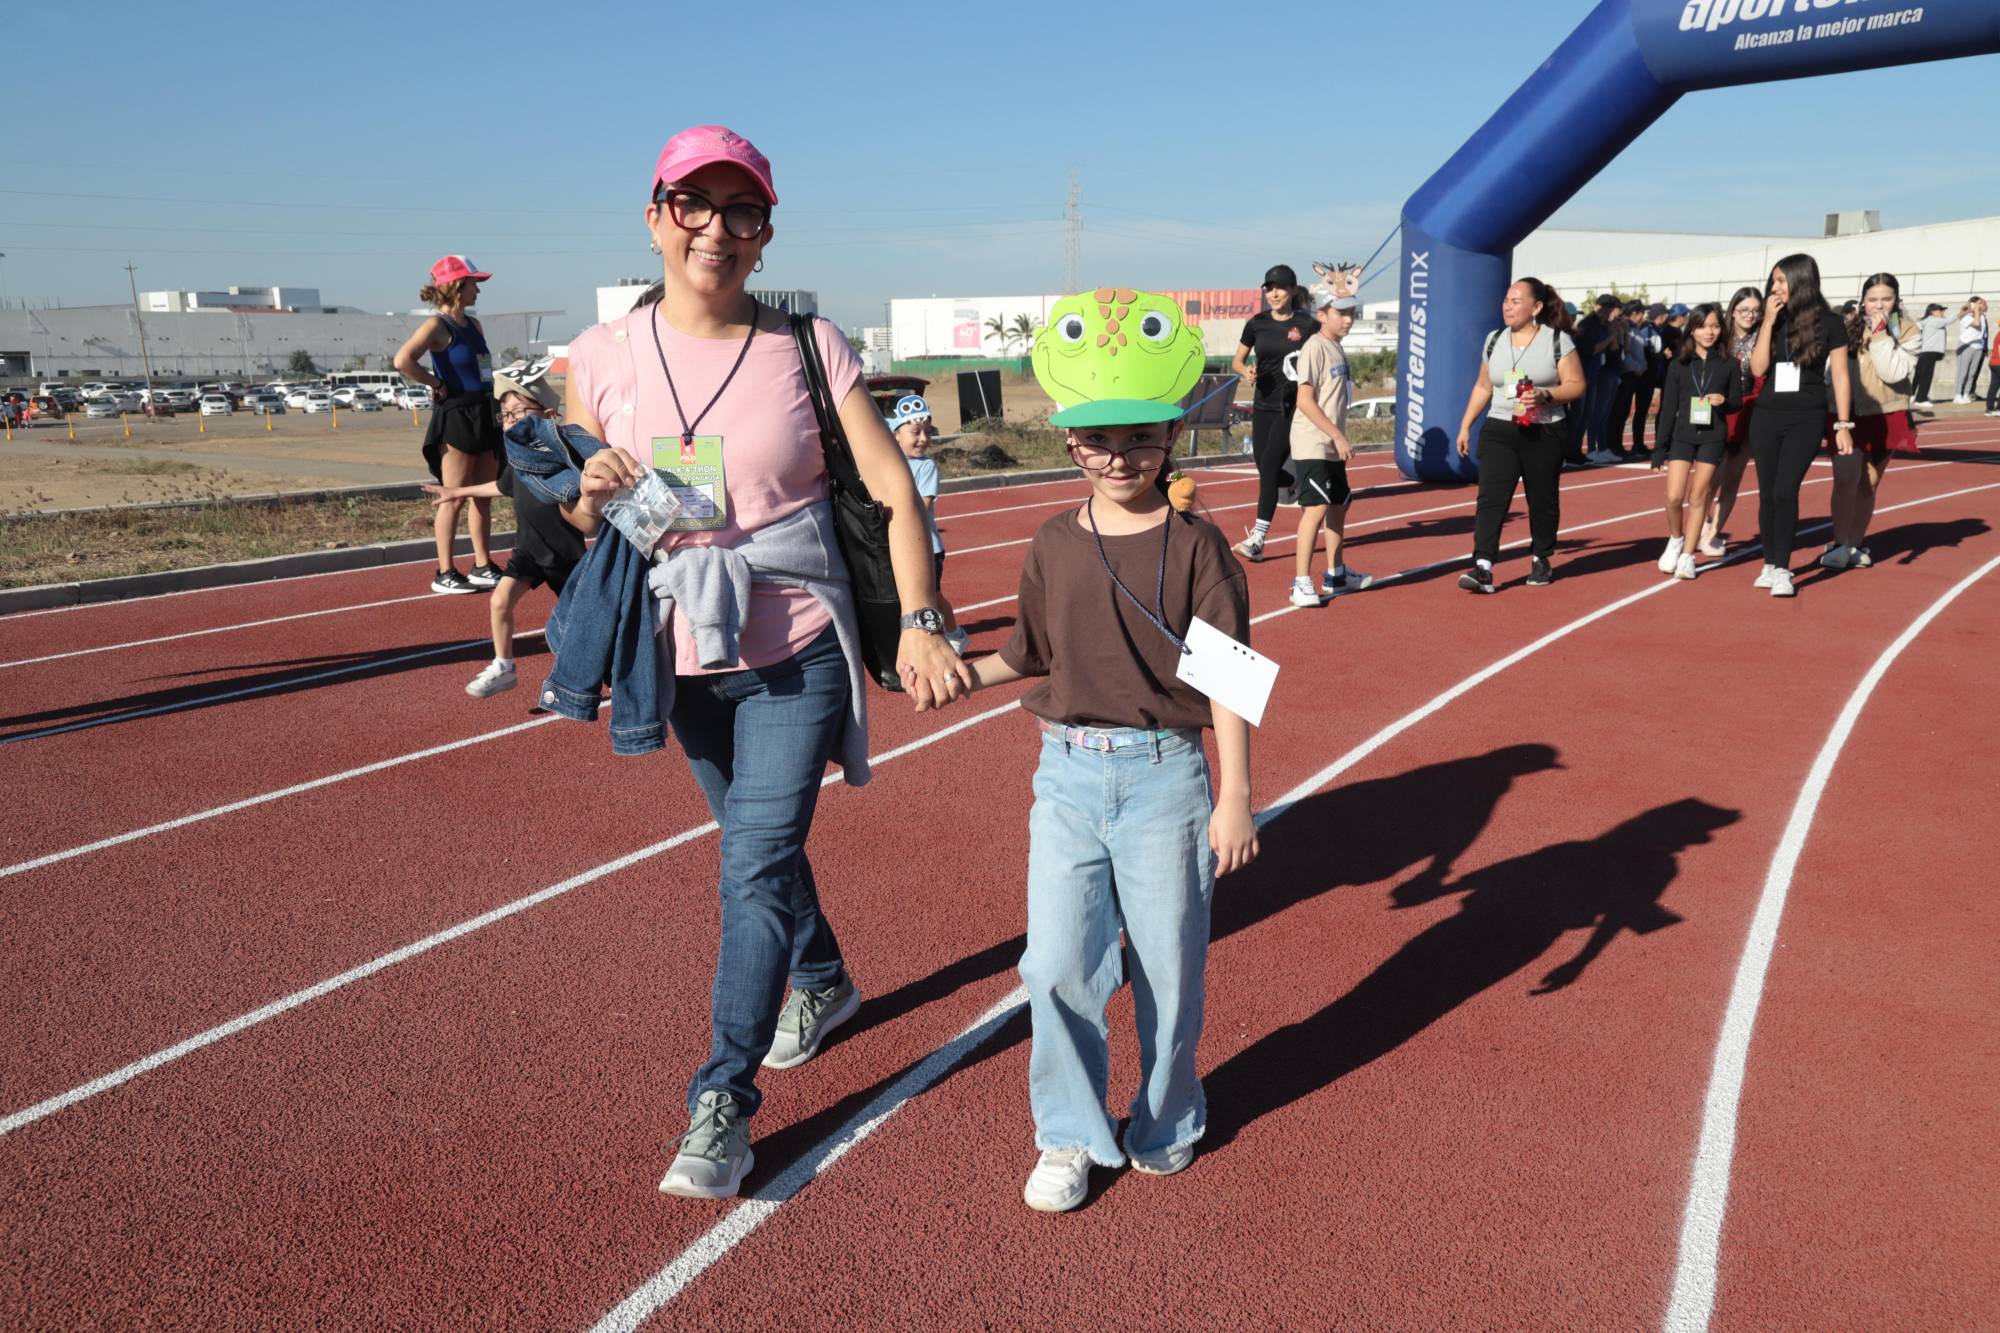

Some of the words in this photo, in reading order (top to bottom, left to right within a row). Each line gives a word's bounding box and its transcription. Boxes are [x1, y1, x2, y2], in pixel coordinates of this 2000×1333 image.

[1734, 28, 1794, 50] Alcanza
[1797, 24, 1812, 41] la
[1815, 16, 1865, 39] mejor
[1866, 7, 1924, 31] marca
[1404, 250, 1429, 462] aportenis.mx
